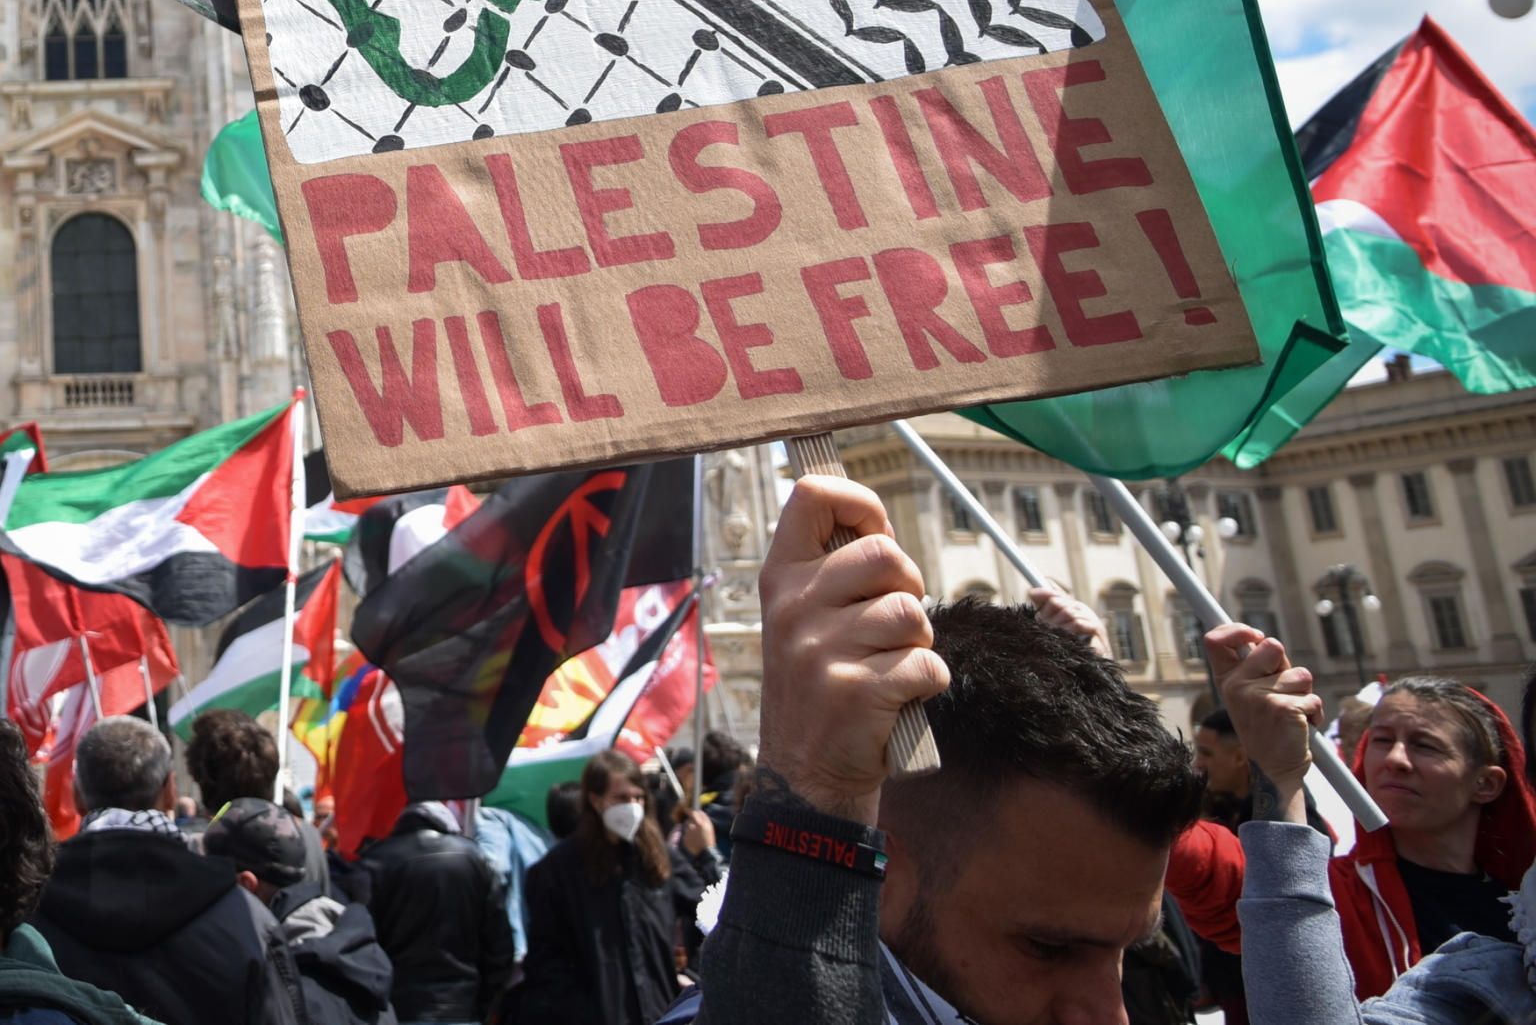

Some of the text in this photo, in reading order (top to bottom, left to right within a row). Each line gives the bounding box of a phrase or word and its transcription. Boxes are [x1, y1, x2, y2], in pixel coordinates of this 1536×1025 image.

[300, 59, 1154, 304] PALESTINE
[326, 208, 1216, 448] WILL BE FREE!
[764, 822, 857, 869] PALESTINE
